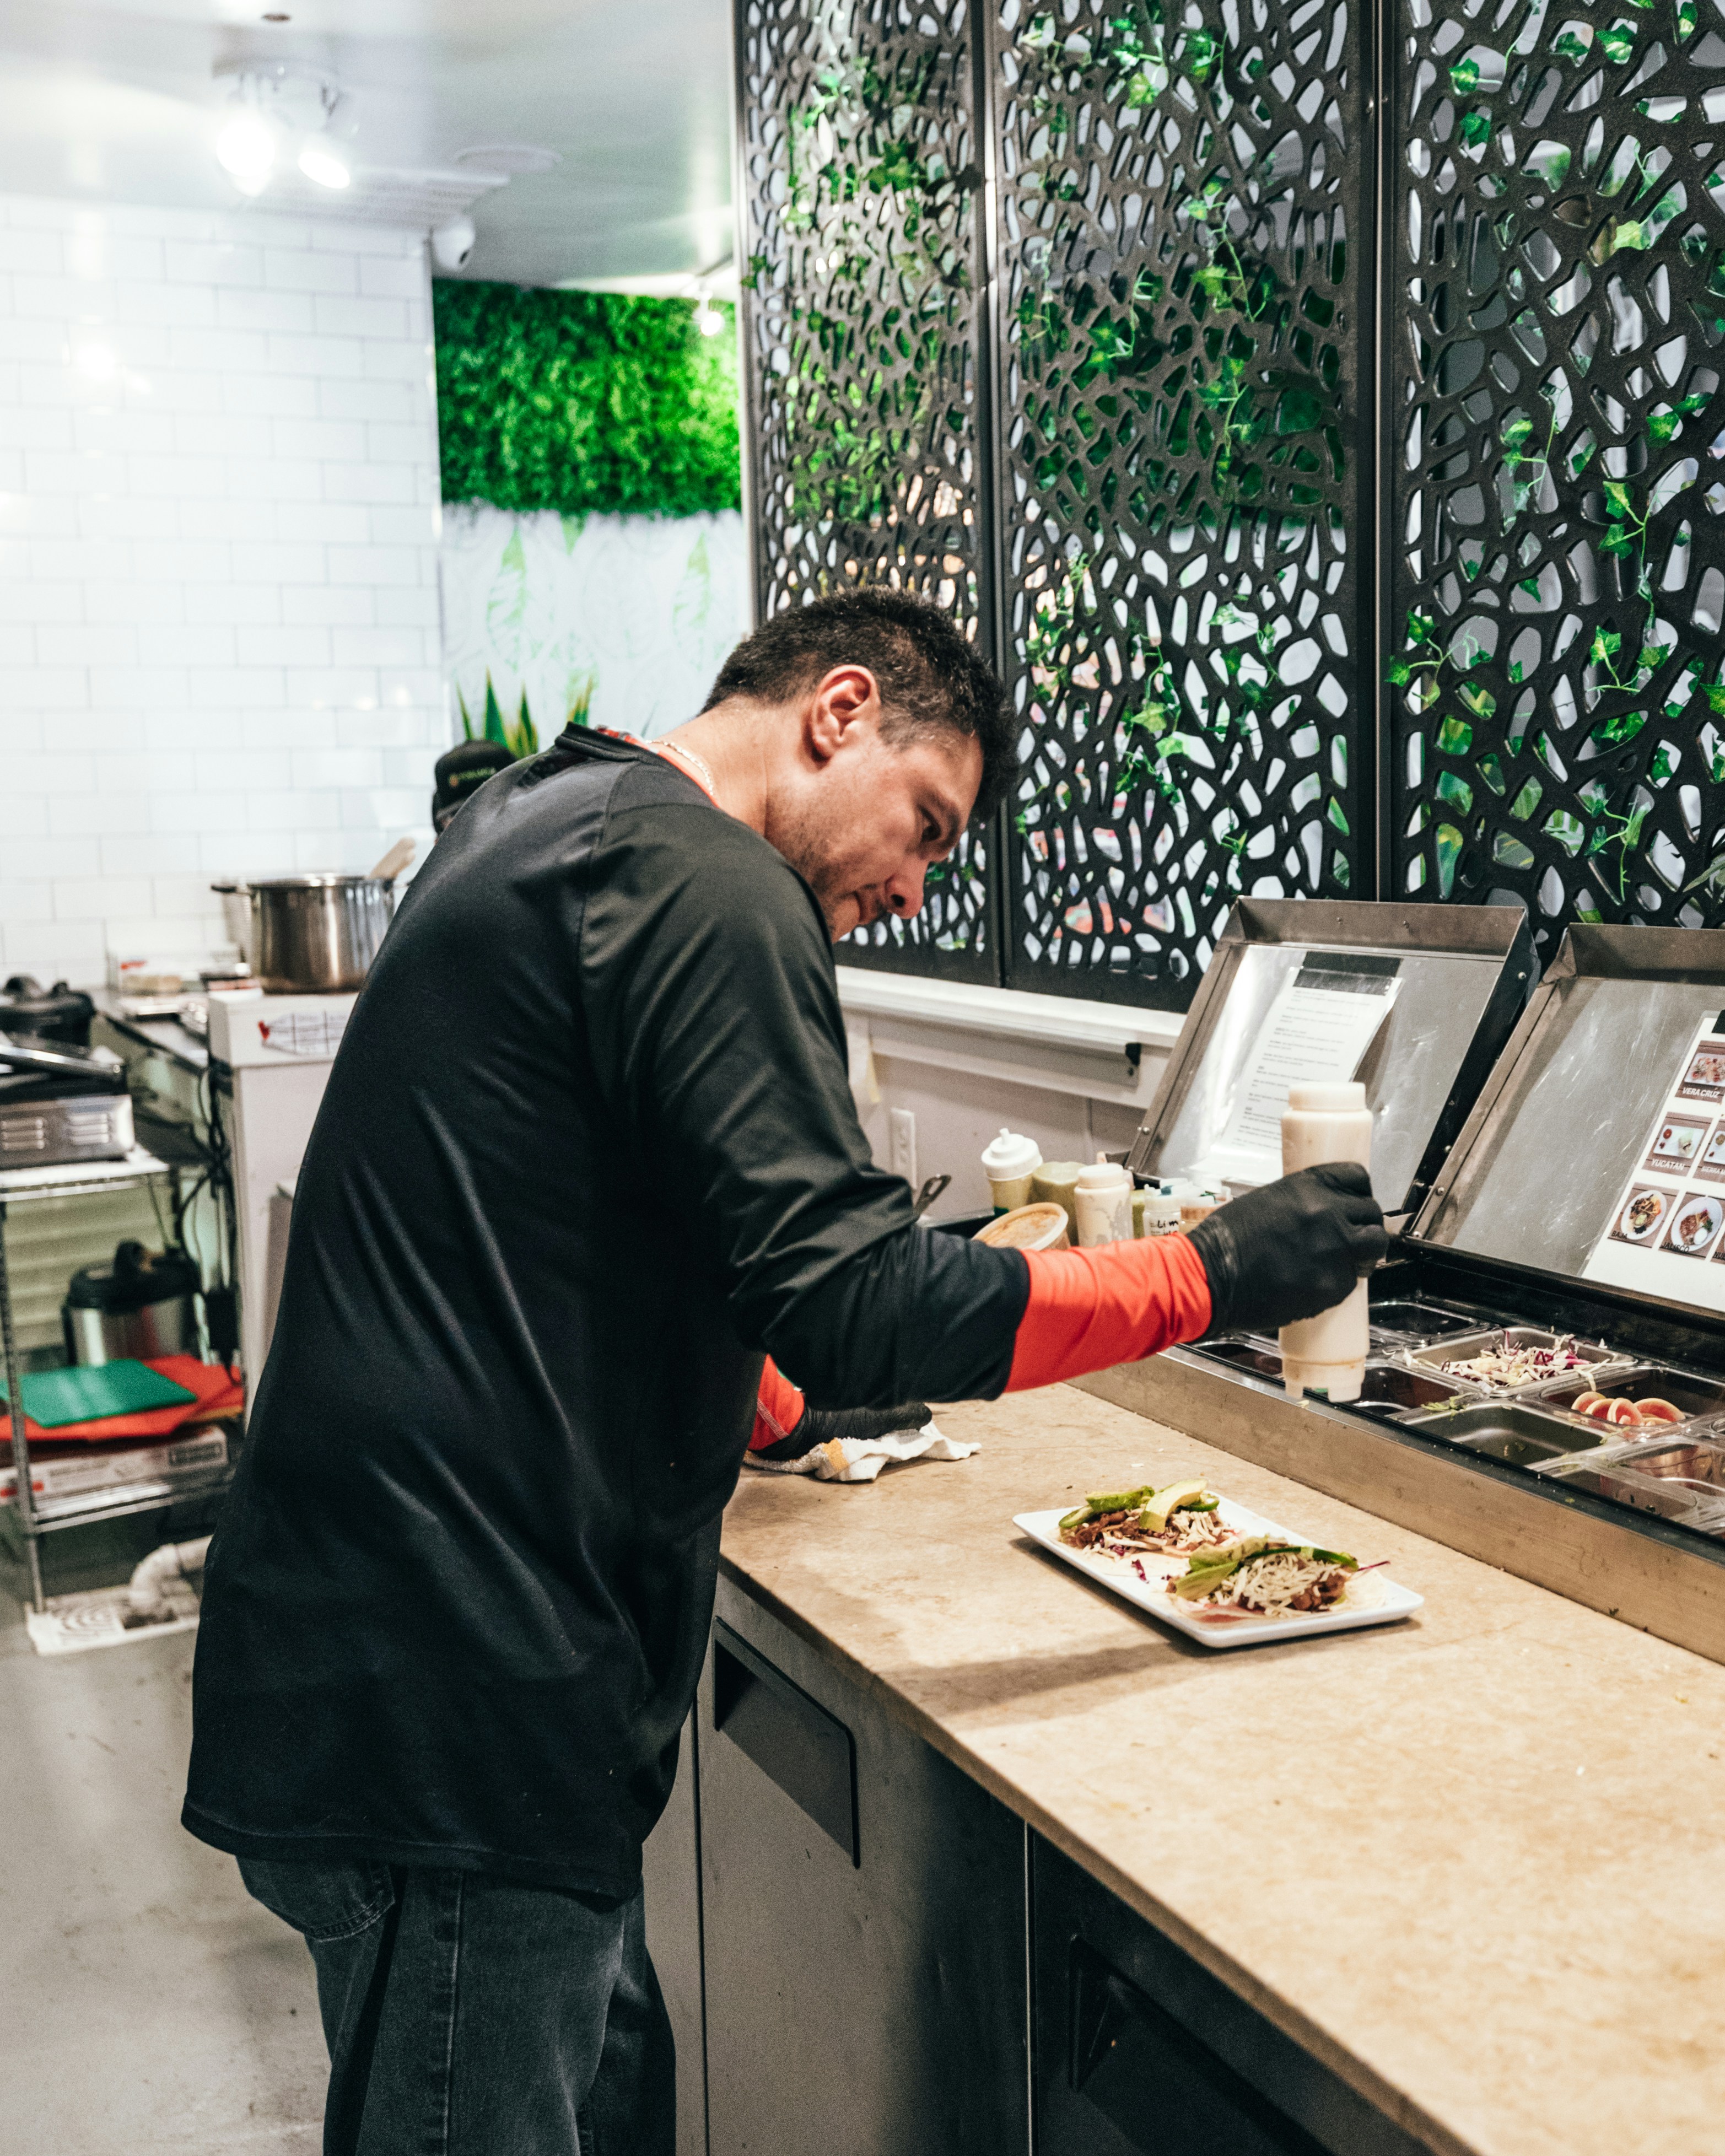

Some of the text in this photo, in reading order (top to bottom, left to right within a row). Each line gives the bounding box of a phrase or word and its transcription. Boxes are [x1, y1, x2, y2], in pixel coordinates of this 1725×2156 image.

[1651, 1158, 1685, 1171] YUCATAN
[1611, 1231, 1627, 1239] BAJA
[1660, 1242, 1690, 1253] JALISCO
